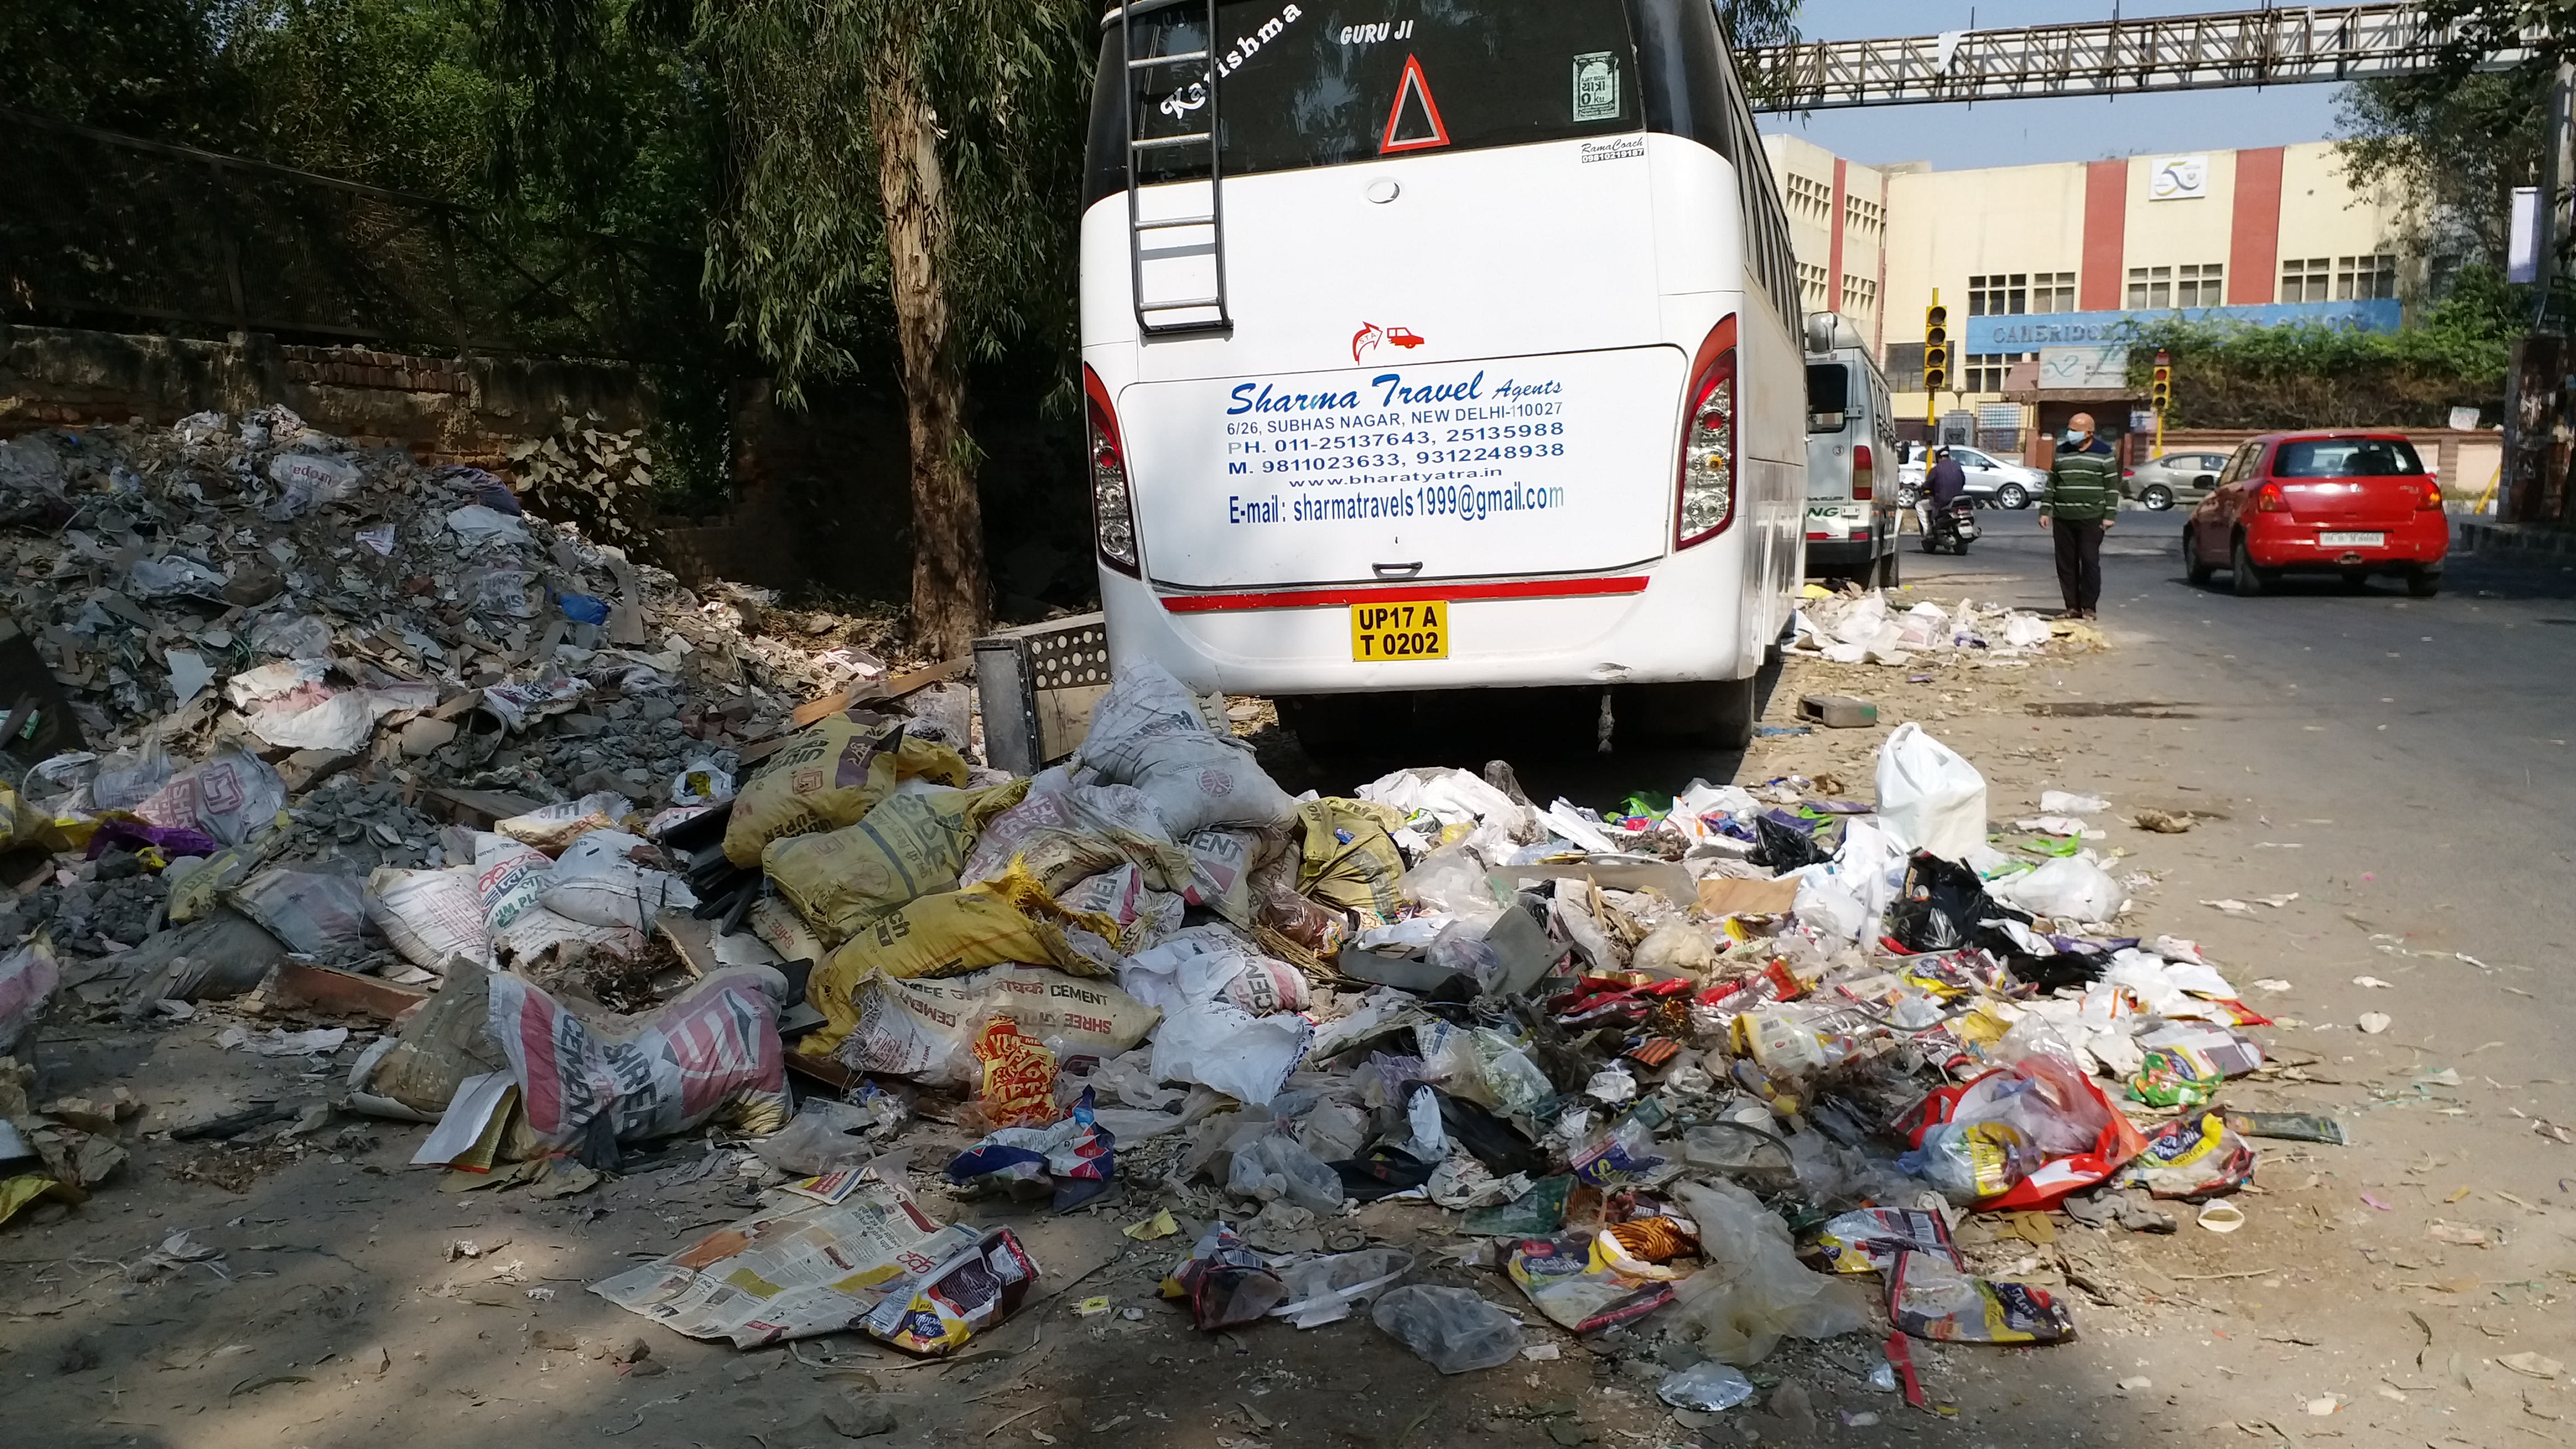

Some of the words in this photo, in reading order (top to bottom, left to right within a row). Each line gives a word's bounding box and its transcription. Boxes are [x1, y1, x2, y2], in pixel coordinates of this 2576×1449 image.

[1340, 22, 1391, 45] GURU
[1394, 20, 1414, 40] JI
[1581, 148, 1644, 163] 09810219187
[1992, 322, 2109, 344] CAMBRIDG
[1227, 382, 1361, 416] Sharma
[1371, 370, 1485, 408] Travel
[1491, 377, 1564, 403] Agents
[1227, 422, 1262, 436] 6/26,
[1267, 416, 1335, 433] SUBHAS
[1340, 413, 1406, 430] NAGAR,
[1411, 409, 1451, 425] NEW
[1455, 400, 1564, 423] DELHI-110027
[1228, 441, 1267, 456] PH.
[1274, 430, 1437, 453] 011-25137643,
[1446, 421, 1565, 444] 25135988
[1228, 461, 1254, 475] M.
[1262, 453, 1407, 474] 9811023633,
[1415, 442, 1565, 466] 9312248938
[292, 465, 333, 486] uropa
[1289, 466, 1503, 489] www.bharatyatra.in
[1229, 494, 1286, 524] E-mail:
[1293, 481, 1565, 522] sharmatravels1999@gmail.com
[1806, 507, 1839, 518] NG
[1359, 607, 1414, 631] UP17
[1422, 606, 1438, 628] A
[1360, 634, 1375, 656] T
[1382, 632, 1439, 655] 0202
[1050, 984, 1108, 1006] CEMENT
[896, 988, 957, 1028] CEMENT
[1063, 1012, 1112, 1035] SHREE
